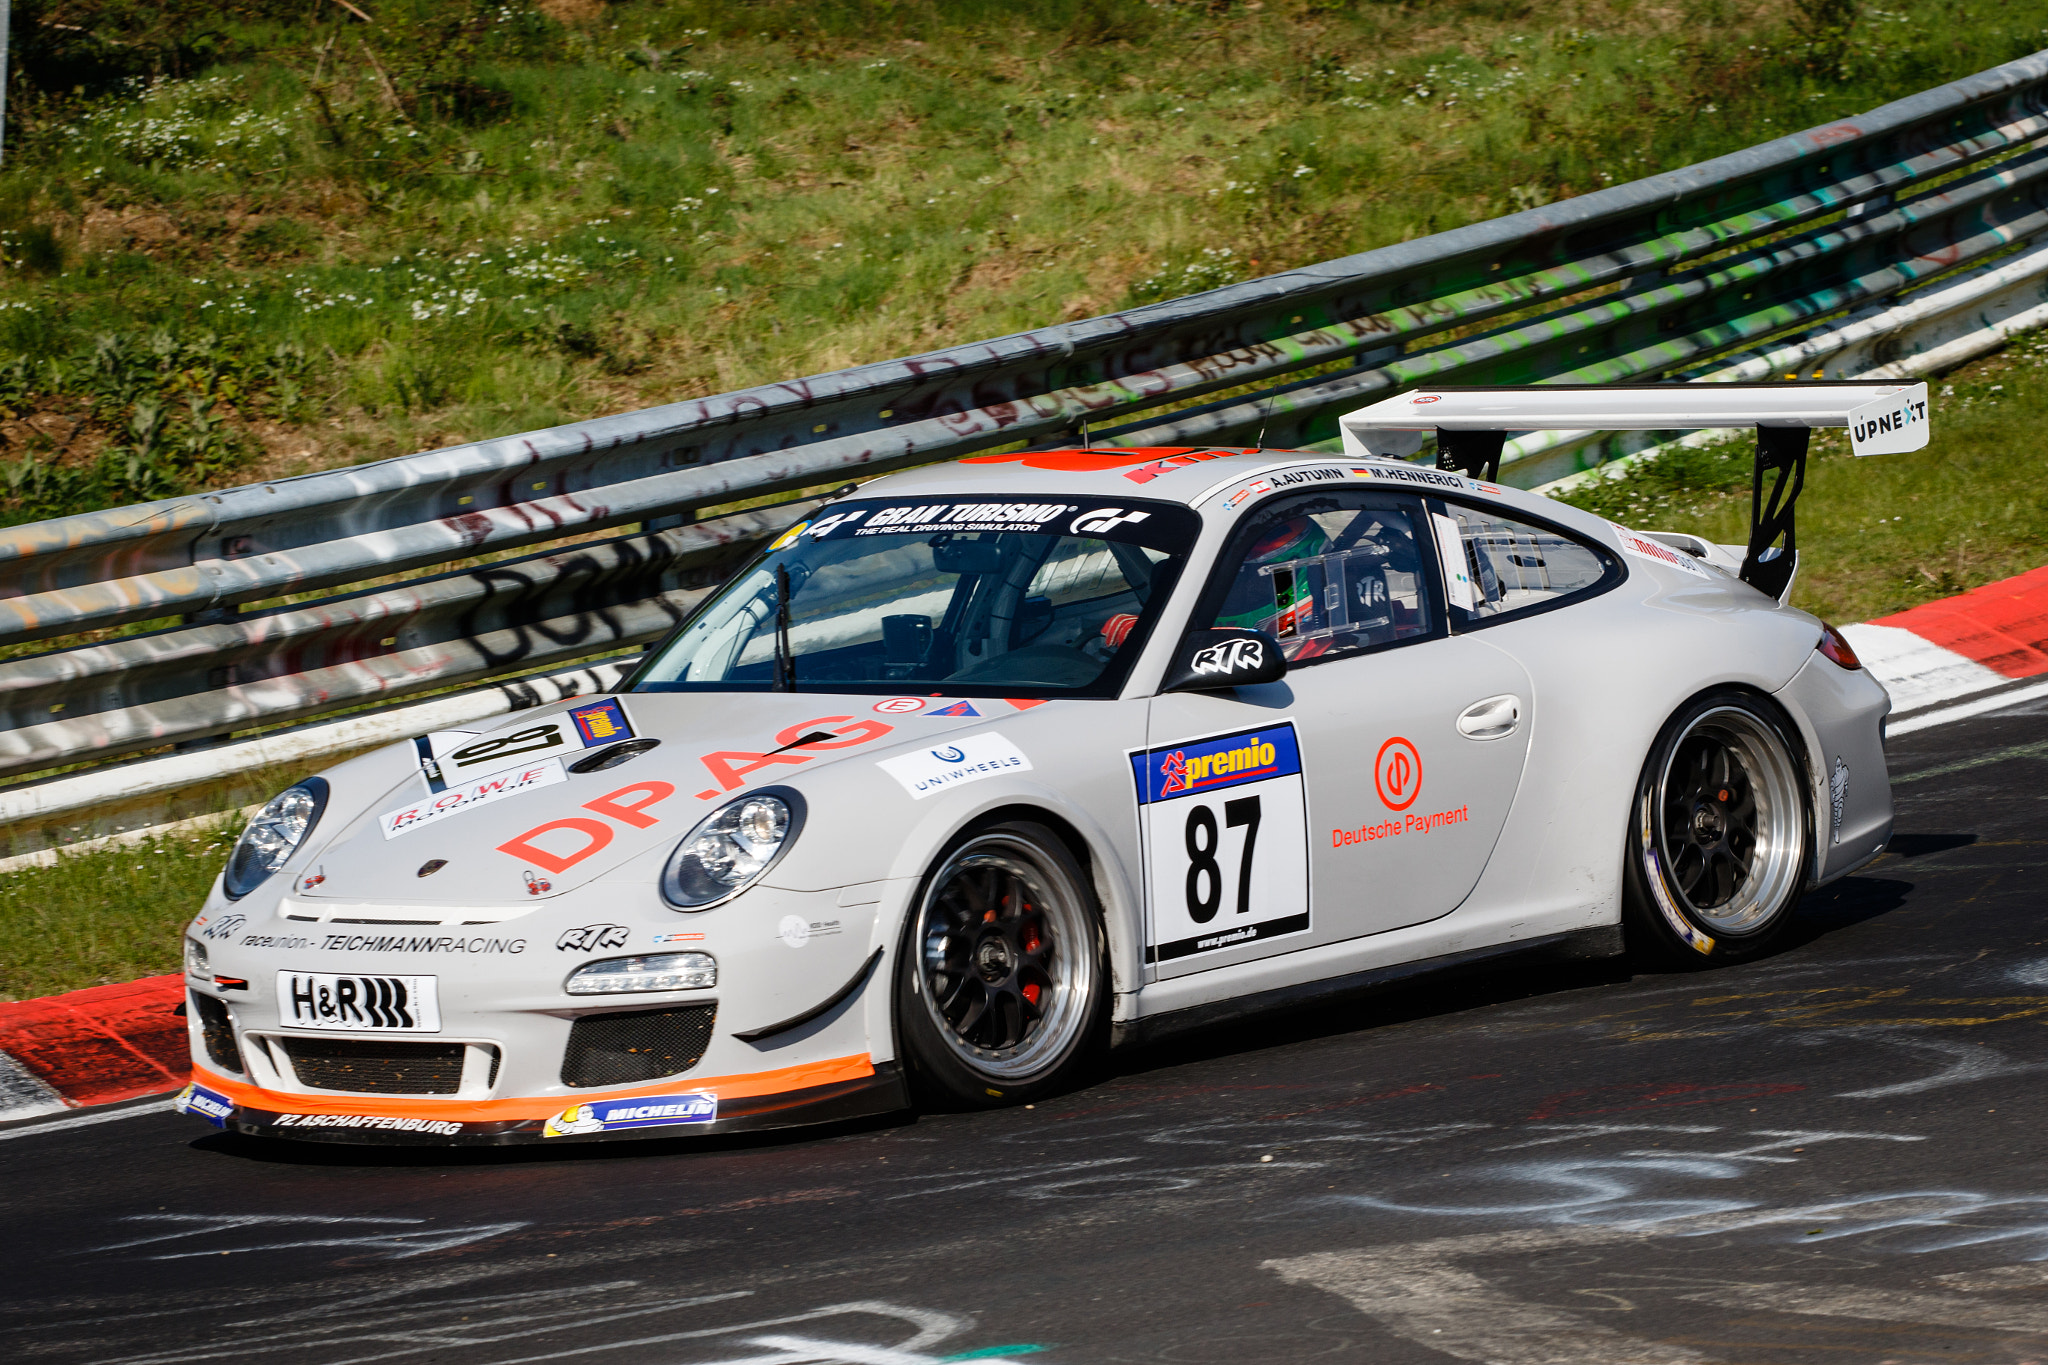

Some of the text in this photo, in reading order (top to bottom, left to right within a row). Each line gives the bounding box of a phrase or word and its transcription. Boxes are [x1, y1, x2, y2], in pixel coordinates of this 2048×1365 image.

[1854, 399, 1925, 442] UPNEXT
[1270, 468, 1344, 488] A.AUTUMN
[1371, 468, 1464, 488] M.HENNERICI
[855, 523, 1041, 535] THE REAL DRIVING SIMULATOR
[864, 505, 949, 526] GRAN
[1191, 638, 1263, 675] RTR
[577, 711, 623, 738] premio
[915, 757, 1021, 791] UNIWHEELS
[1184, 736, 1276, 789] premio
[392, 779, 541, 831] MOTOR OIL
[1332, 804, 1468, 848] Deutsche Payment
[1185, 795, 1261, 923] 87
[556, 923, 630, 951] RTR
[1197, 926, 1258, 949] www.premio.de
[292, 975, 364, 1026] H&R
[272, 1113, 464, 1136] PZ ASCHAFFENBURG
[605, 1103, 714, 1122] MICHELIN
